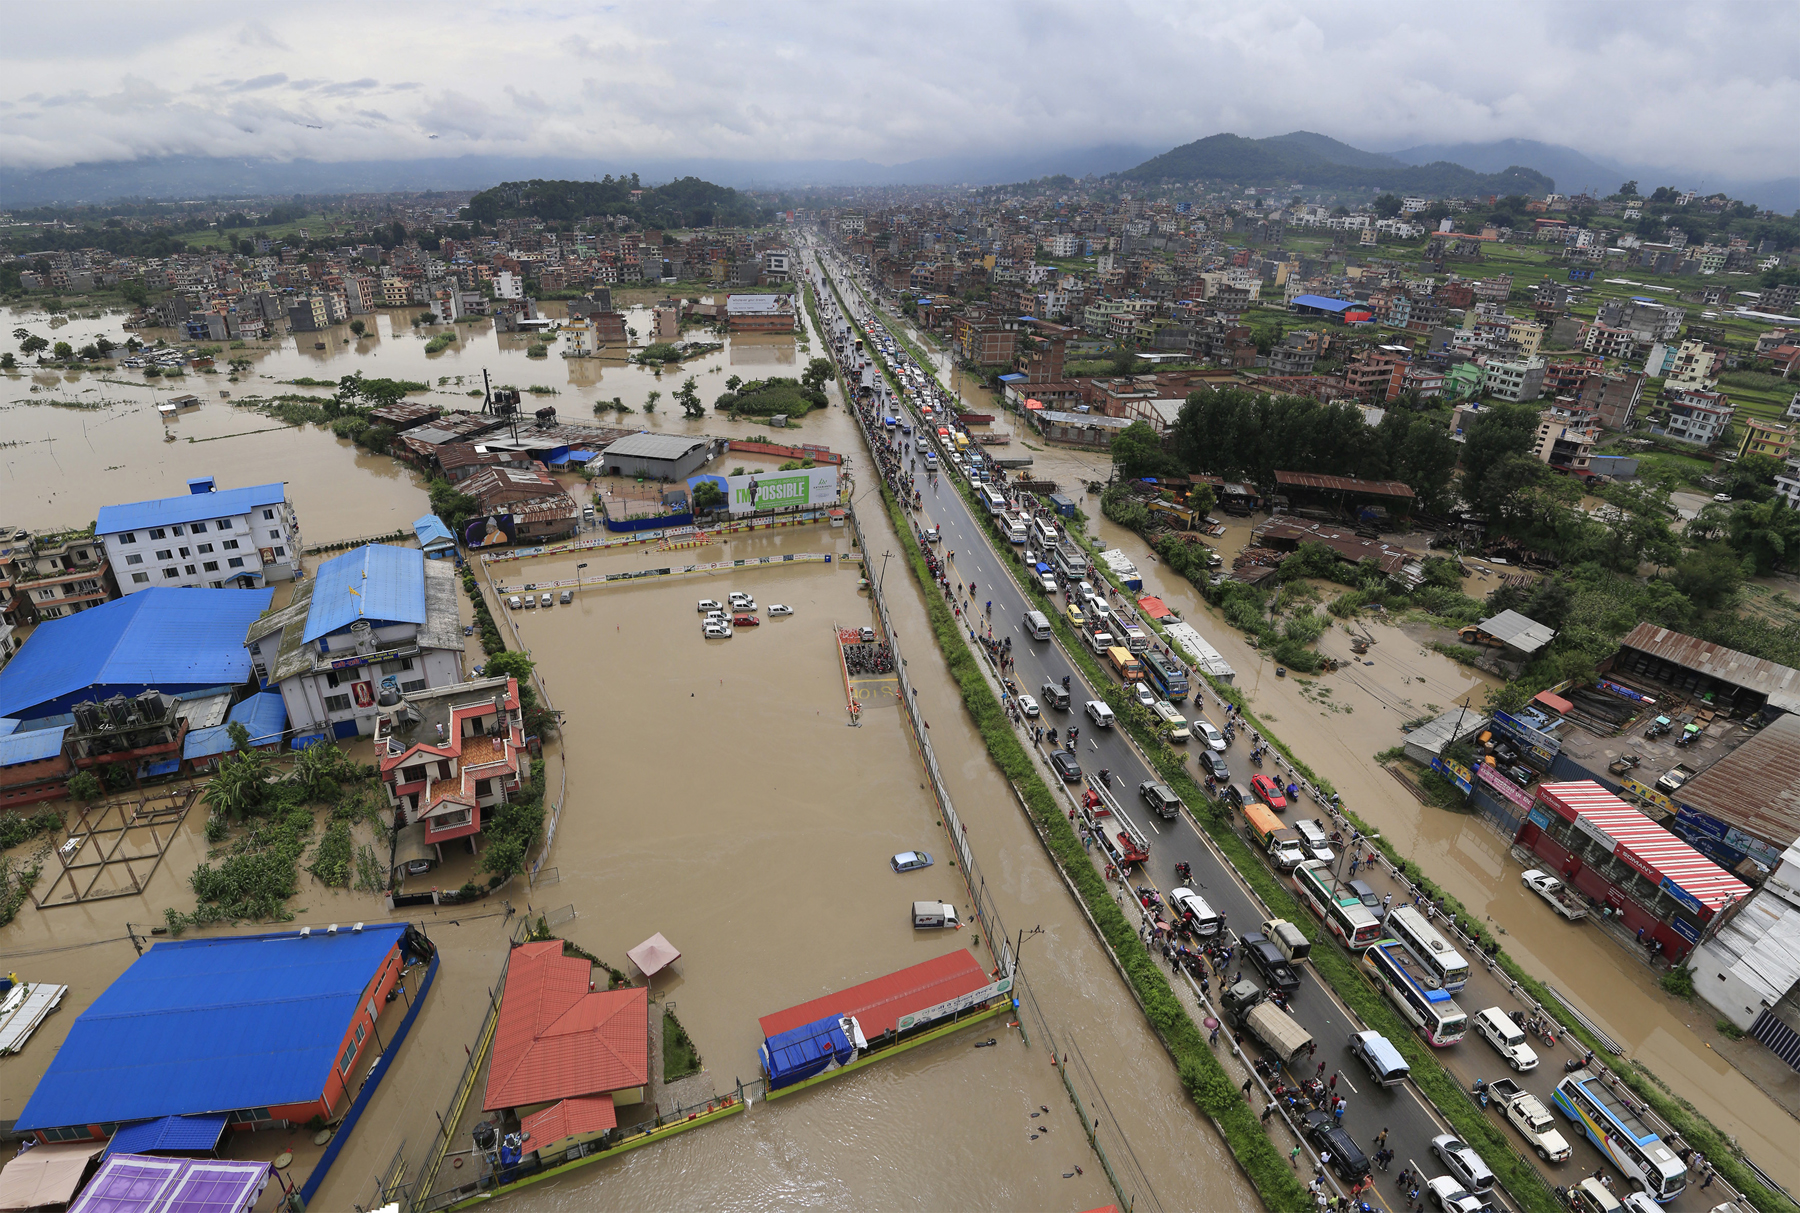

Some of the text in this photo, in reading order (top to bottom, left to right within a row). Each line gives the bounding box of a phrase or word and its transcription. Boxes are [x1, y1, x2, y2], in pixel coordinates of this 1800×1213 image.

[736, 482, 805, 504] I'M POSSIBLE
[1620, 850, 1655, 876] SOMANY
